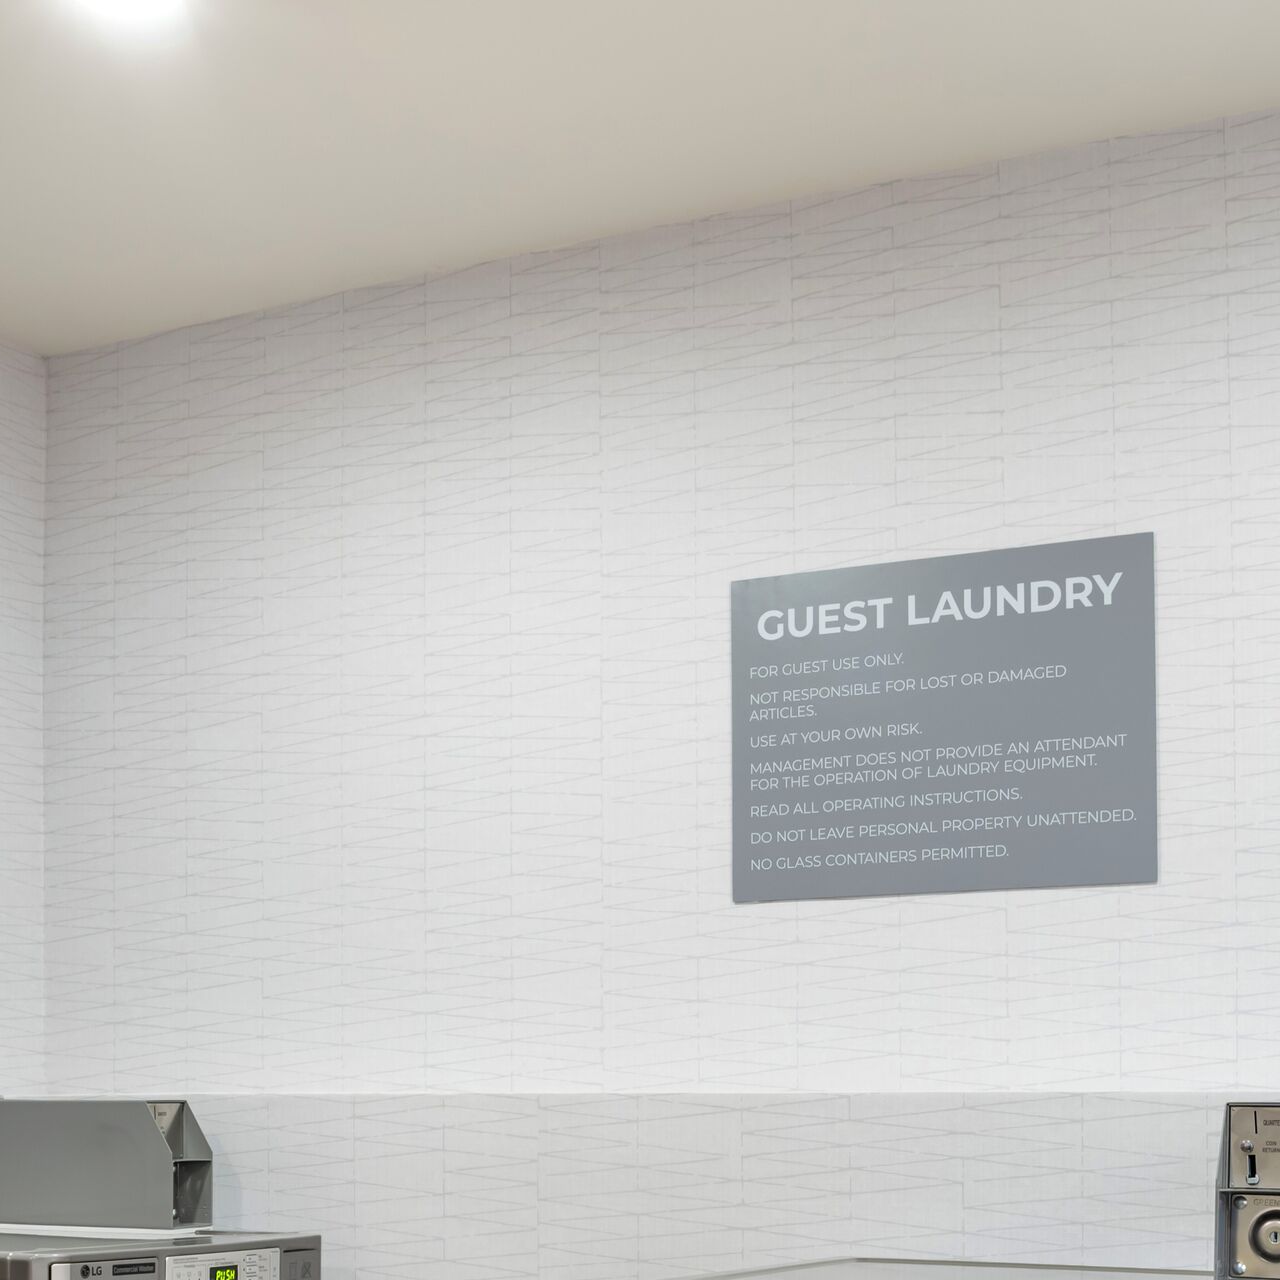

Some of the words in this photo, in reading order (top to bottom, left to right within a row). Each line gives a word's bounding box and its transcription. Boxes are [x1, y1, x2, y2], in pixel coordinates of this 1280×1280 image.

[757, 597, 893, 641] GUEST
[907, 572, 1123, 626] LAUNDRY
[750, 665, 778, 679] FOR
[782, 659, 828, 676] GUEST
[832, 656, 860, 671] USE
[864, 652, 904, 668] ONLY.
[750, 690, 779, 705] NOT
[783, 680, 881, 702] RESPONSIBLE
[885, 678, 916, 693] FOR
[920, 674, 957, 690] LOST
[961, 672, 984, 686] OR
[988, 665, 1067, 684] DAMAGED
[749, 704, 817, 722] ARTICLES.
[750, 734, 777, 749] USE
[781, 732, 799, 747] AT
[801, 728, 841, 744] YOUR
[845, 725, 882, 741] OWN
[887, 722, 923, 737] RISK.
[750, 754, 851, 775] MANAGEMENT
[856, 751, 896, 767] DOES
[901, 748, 931, 764] NOT
[936, 742, 1003, 761] PROVIDE
[1007, 740, 1029, 755] AN
[1033, 733, 1128, 753] ATTENDANT
[750, 777, 779, 792] FOR
[782, 775, 810, 789] THE
[814, 768, 897, 787] OPERATION
[902, 766, 923, 780] OF
[927, 761, 999, 779] LAUNDRY
[1004, 754, 1098, 775] EQUIPMENT.
[750, 803, 789, 818] READ
[793, 801, 819, 815] ALL
[822, 795, 905, 813] OPERATING
[909, 787, 1023, 806] INSTRUCTIONS.
[750, 831, 772, 845] DO
[777, 829, 806, 843] NOT
[810, 825, 855, 841] LEAVE
[859, 821, 938, 838] PERSONAL
[942, 815, 1022, 833] PROPERTY
[1027, 808, 1137, 828] UNATTENDED.
[750, 858, 772, 872] NO
[776, 854, 822, 870] GLASS
[825, 848, 917, 867] CONTAINERS
[921, 844, 1009, 862] PERMITTED.
